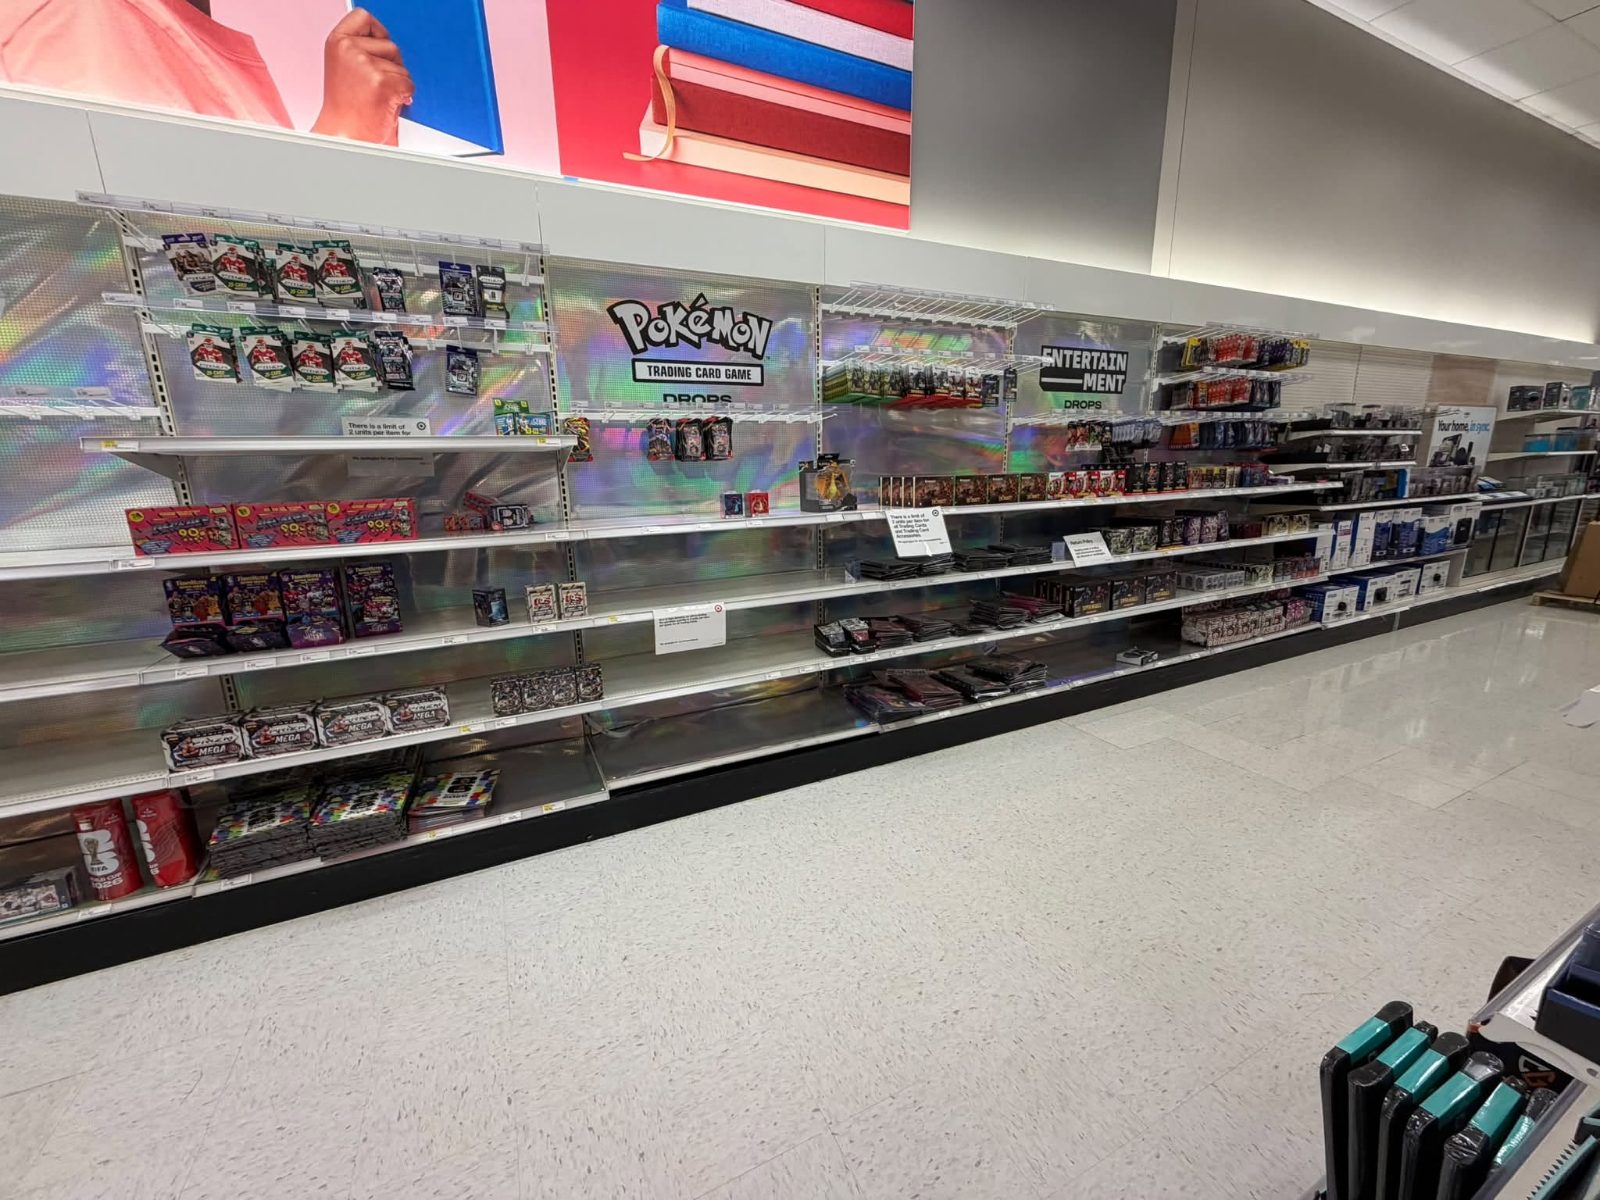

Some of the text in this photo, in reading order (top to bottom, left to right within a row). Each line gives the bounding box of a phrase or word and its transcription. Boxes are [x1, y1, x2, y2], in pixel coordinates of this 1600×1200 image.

[1042, 347, 1127, 371] ENTERTAIN
[647, 365, 752, 380] TRADING CARD GAME
[1083, 372, 1125, 392] MENT
[1064, 400, 1102, 409] DROPS
[1438, 420, 1451, 431] Your
[413, 711, 436, 720] MEGA
[348, 722, 373, 732] MEGA
[275, 733, 301, 743] MEGA
[199, 745, 227, 756] MEGA
